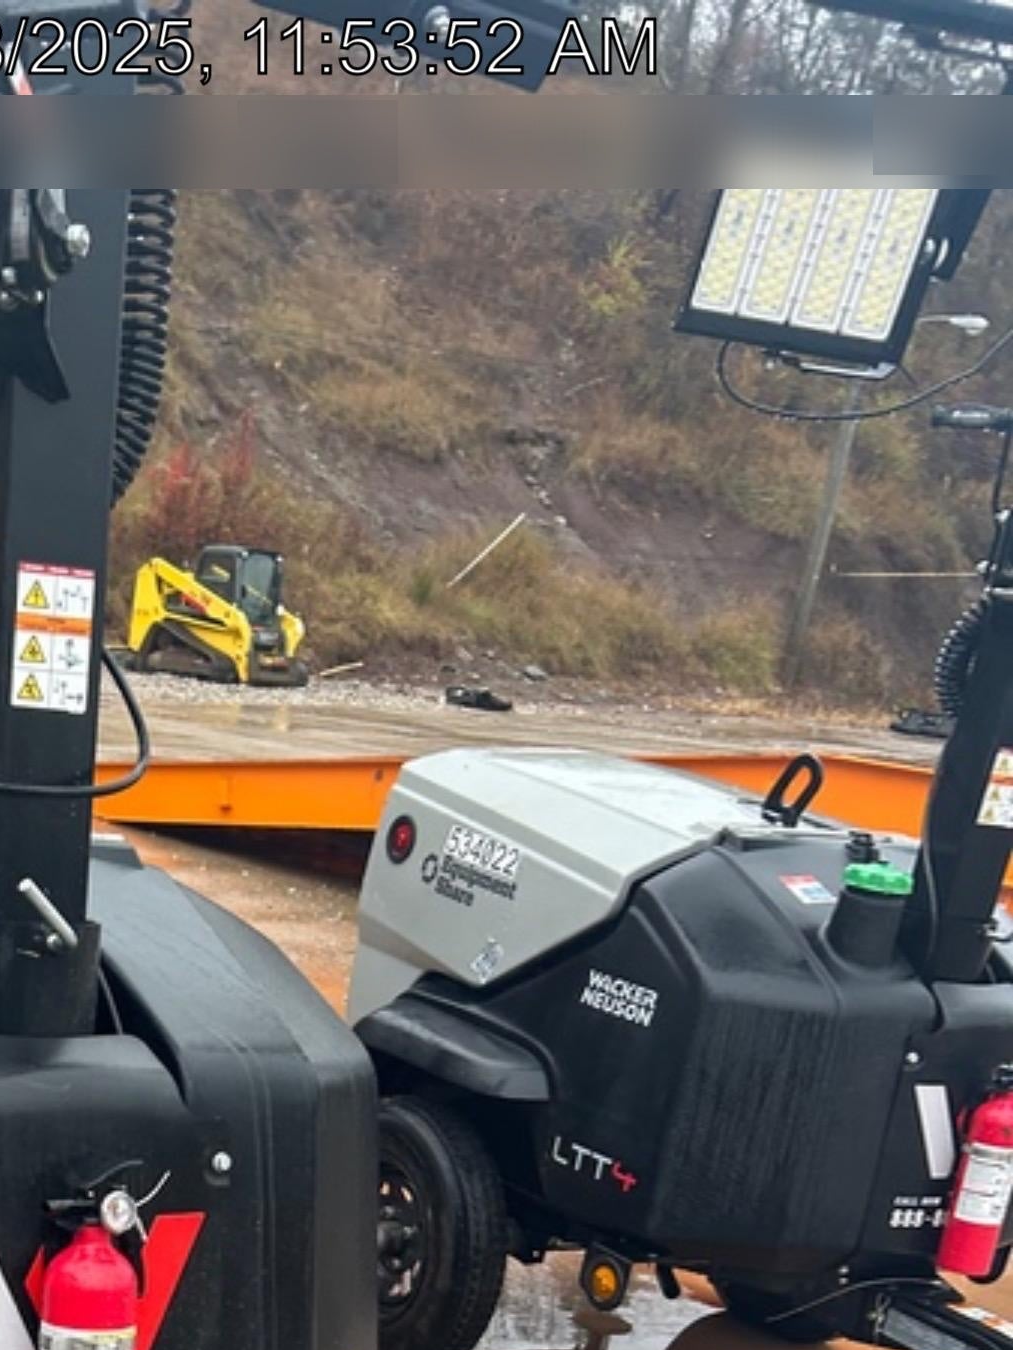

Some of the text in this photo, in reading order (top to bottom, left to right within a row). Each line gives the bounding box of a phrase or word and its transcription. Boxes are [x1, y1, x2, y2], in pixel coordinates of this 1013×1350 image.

[580, 986, 655, 1027] NEUSON
[589, 968, 657, 1009] WACKER
[552, 1135, 636, 1192] LTT4
